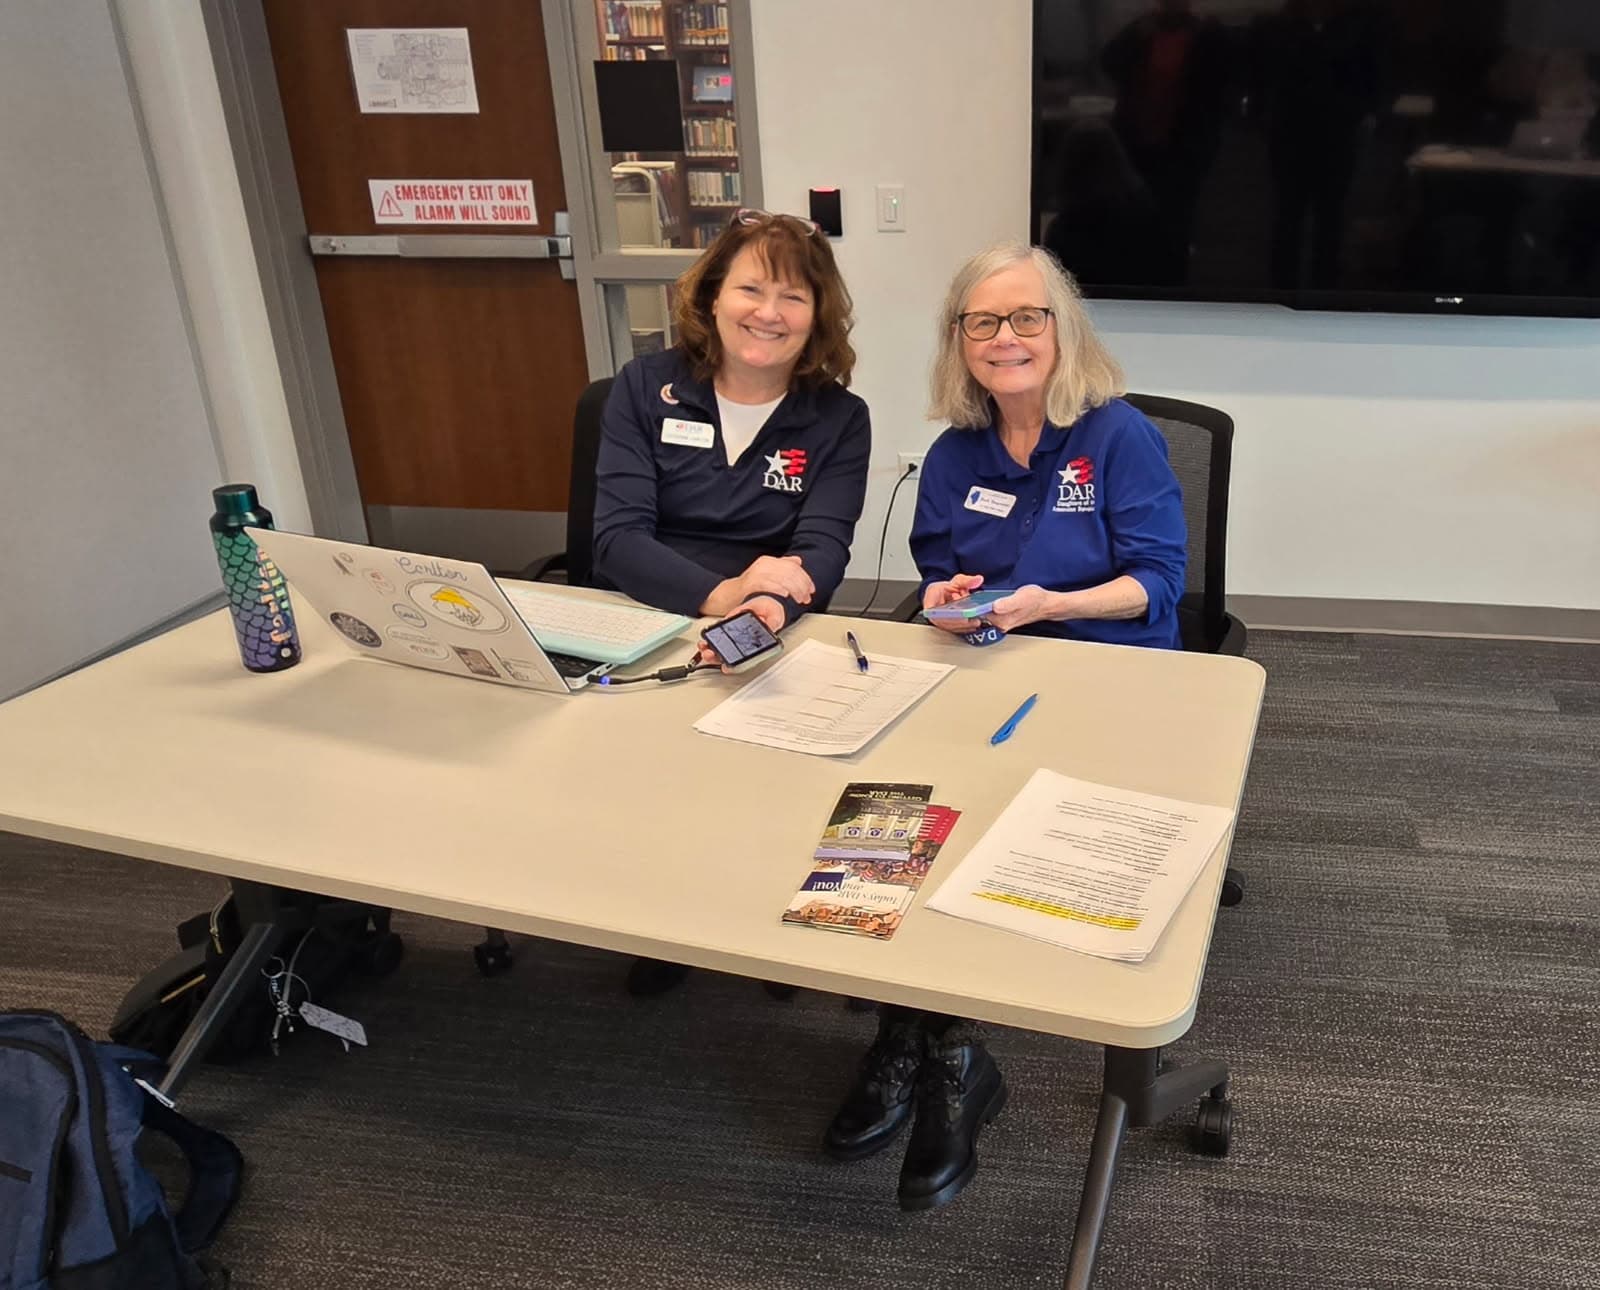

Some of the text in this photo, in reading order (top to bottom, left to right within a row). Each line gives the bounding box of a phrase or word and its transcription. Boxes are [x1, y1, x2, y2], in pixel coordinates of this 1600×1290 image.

[394, 185, 528, 200] EMERGENCY EXIT ONLY
[415, 205, 531, 221] ALARM WILL SOUND
[762, 472, 803, 492] DAR
[1057, 484, 1095, 501] DAR
[812, 881, 840, 891] You!
[862, 892, 898, 905] Today's
